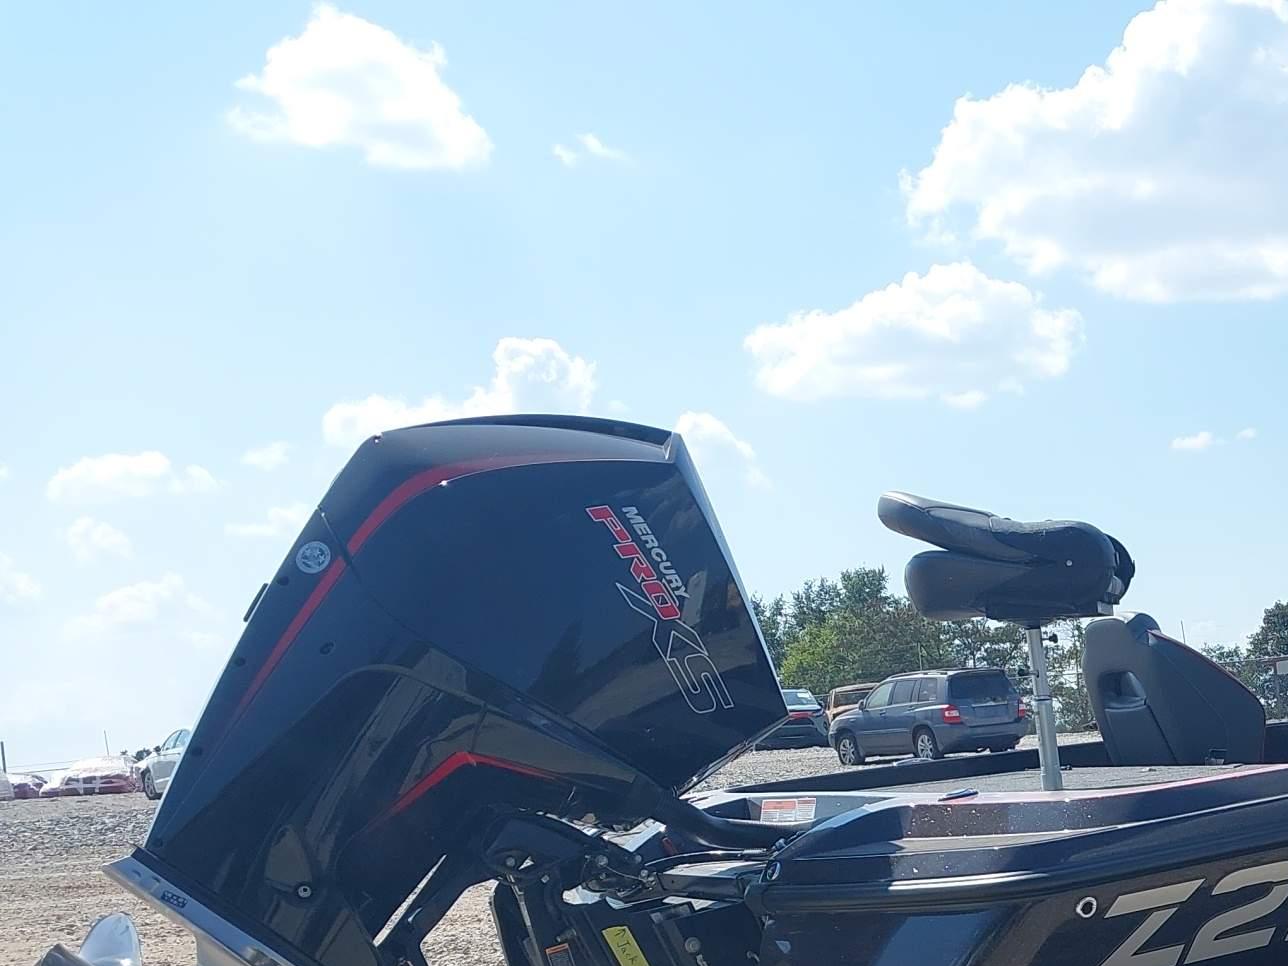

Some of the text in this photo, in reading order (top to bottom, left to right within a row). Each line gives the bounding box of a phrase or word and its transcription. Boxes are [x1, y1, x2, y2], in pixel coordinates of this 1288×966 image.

[585, 505, 681, 620] PRO
[621, 505, 690, 600] MERCURY
[615, 582, 735, 714] XS
